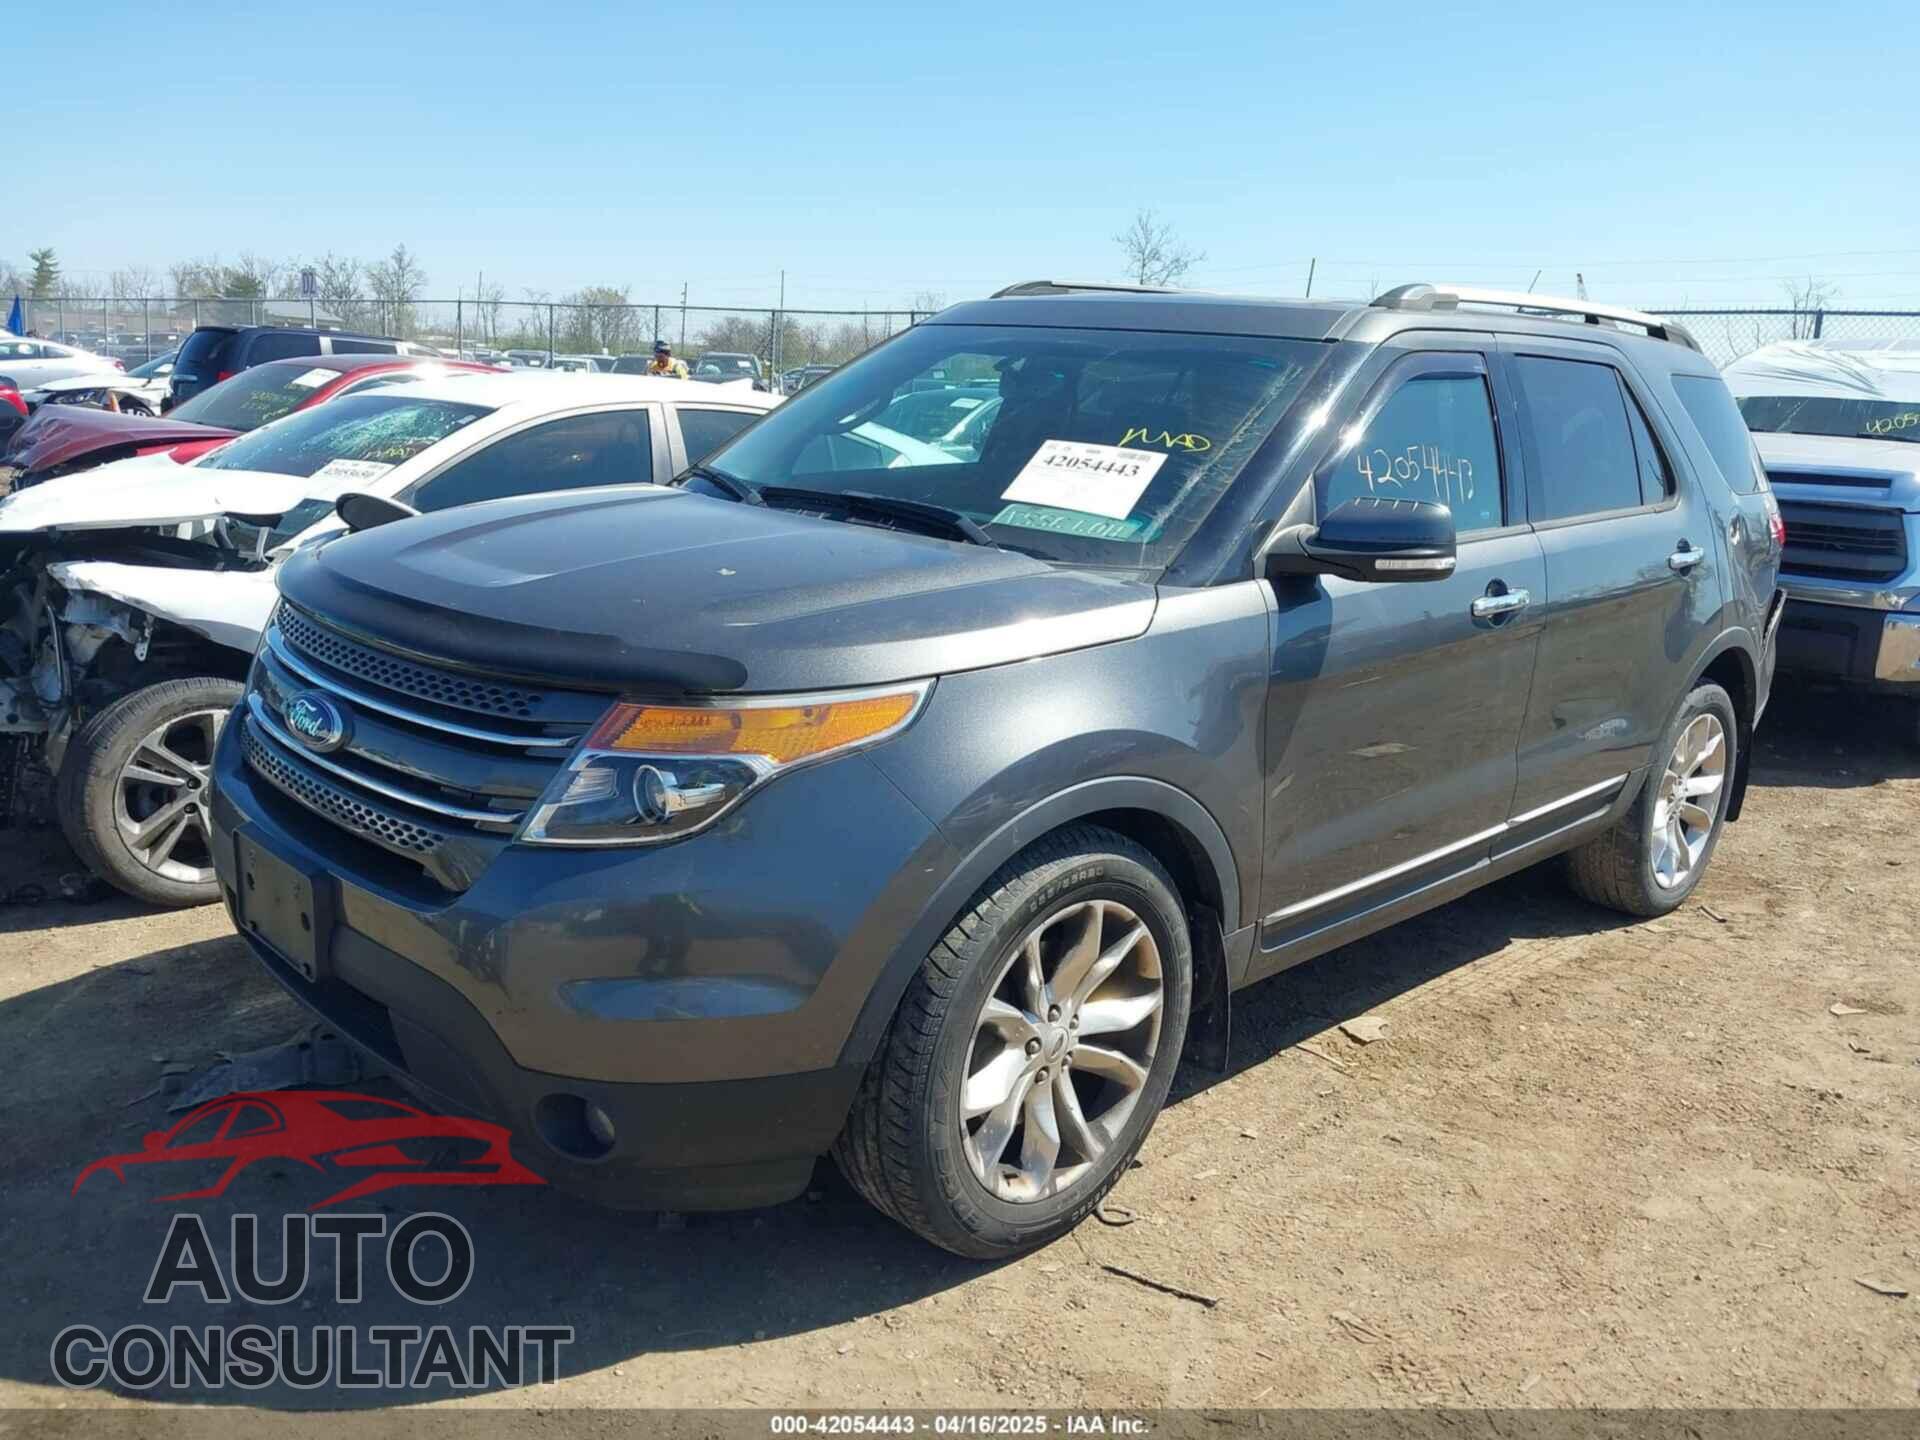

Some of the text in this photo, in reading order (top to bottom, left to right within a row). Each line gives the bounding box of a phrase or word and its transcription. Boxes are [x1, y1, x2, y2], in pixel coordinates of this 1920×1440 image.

[1866, 412, 1919, 433] 4205
[1042, 454, 1141, 478] 42054443
[291, 699, 323, 737] Ford
